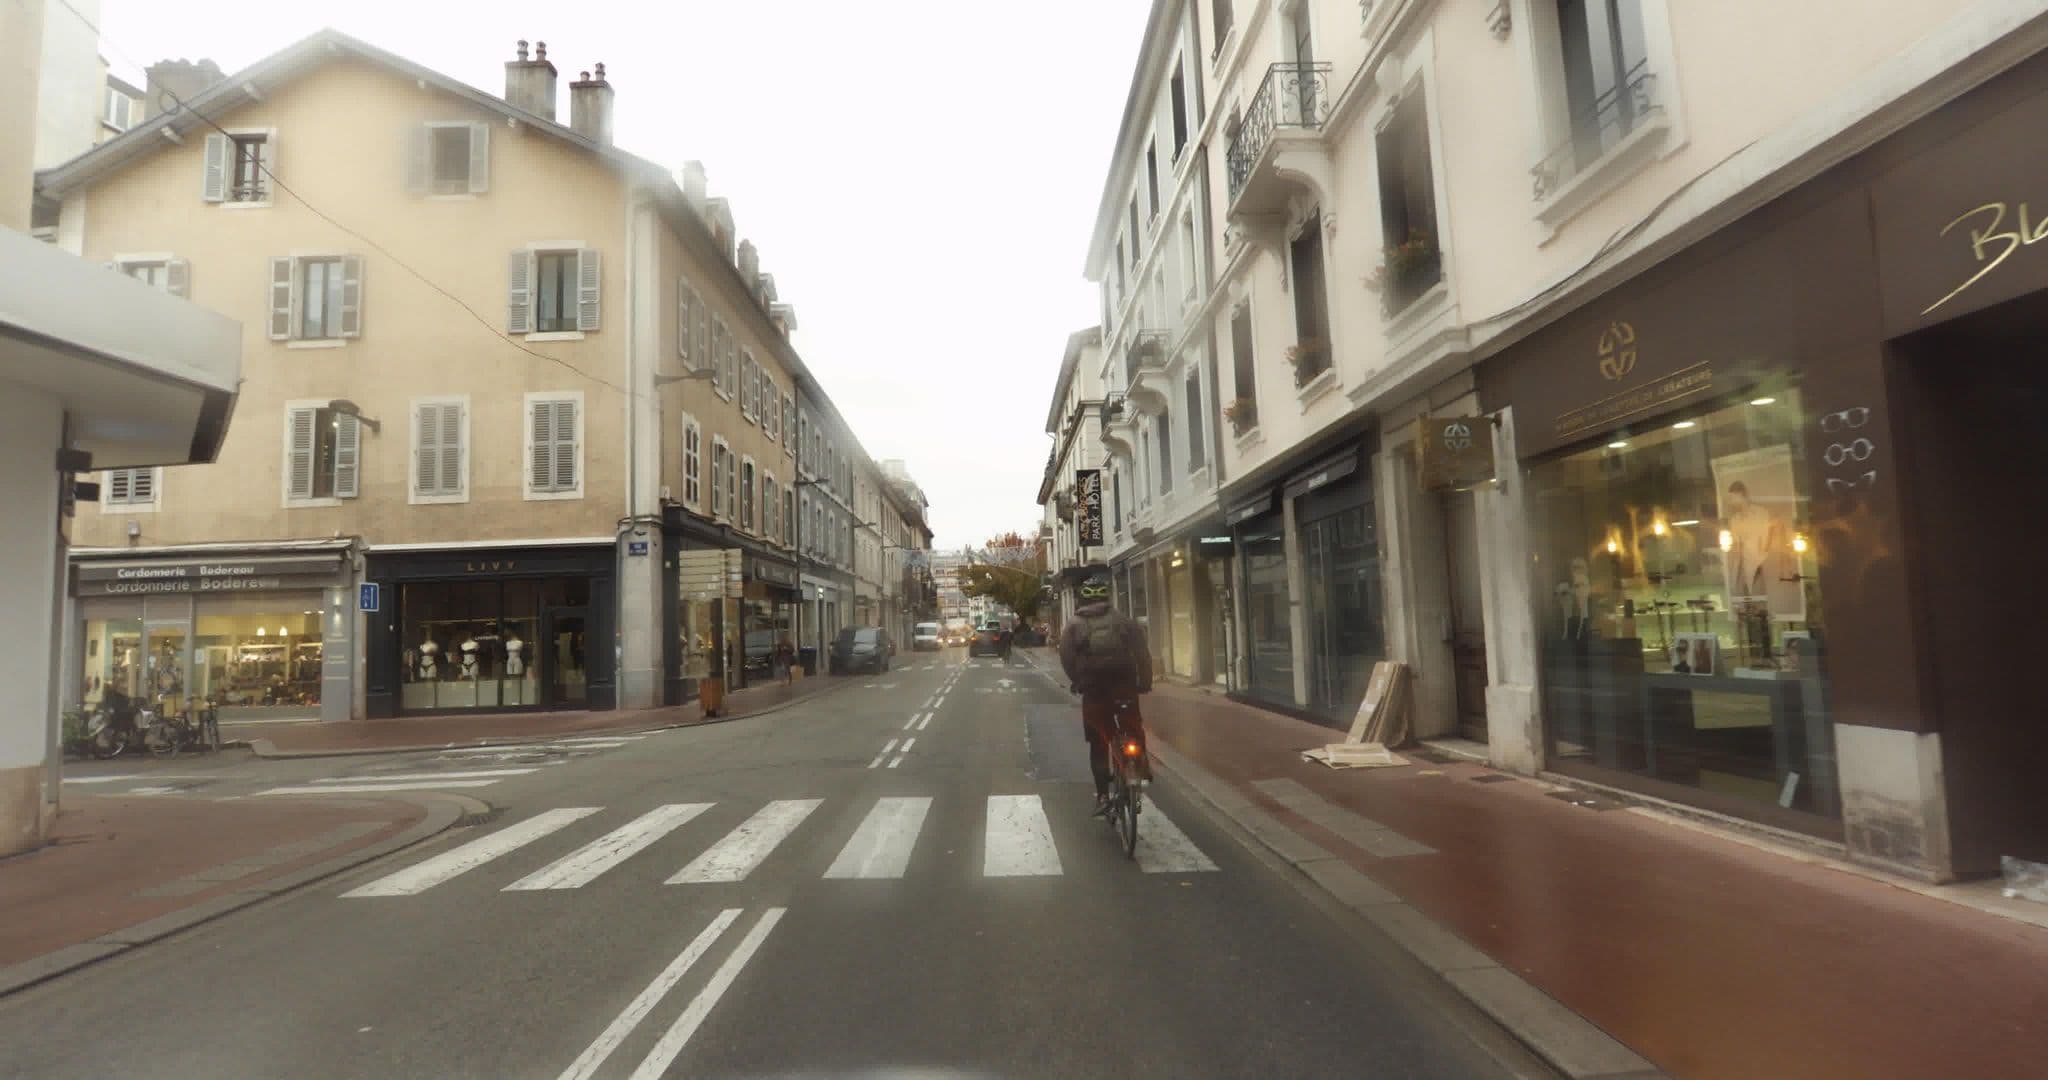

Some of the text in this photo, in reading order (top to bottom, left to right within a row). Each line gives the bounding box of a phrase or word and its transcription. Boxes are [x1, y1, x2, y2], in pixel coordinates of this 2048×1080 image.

[1091, 514, 1101, 540] PARK
[117, 565, 255, 579] Cordonnerie Bodereau
[466, 561, 516, 572] LIVY
[105, 579, 190, 593] Cordonnerie
